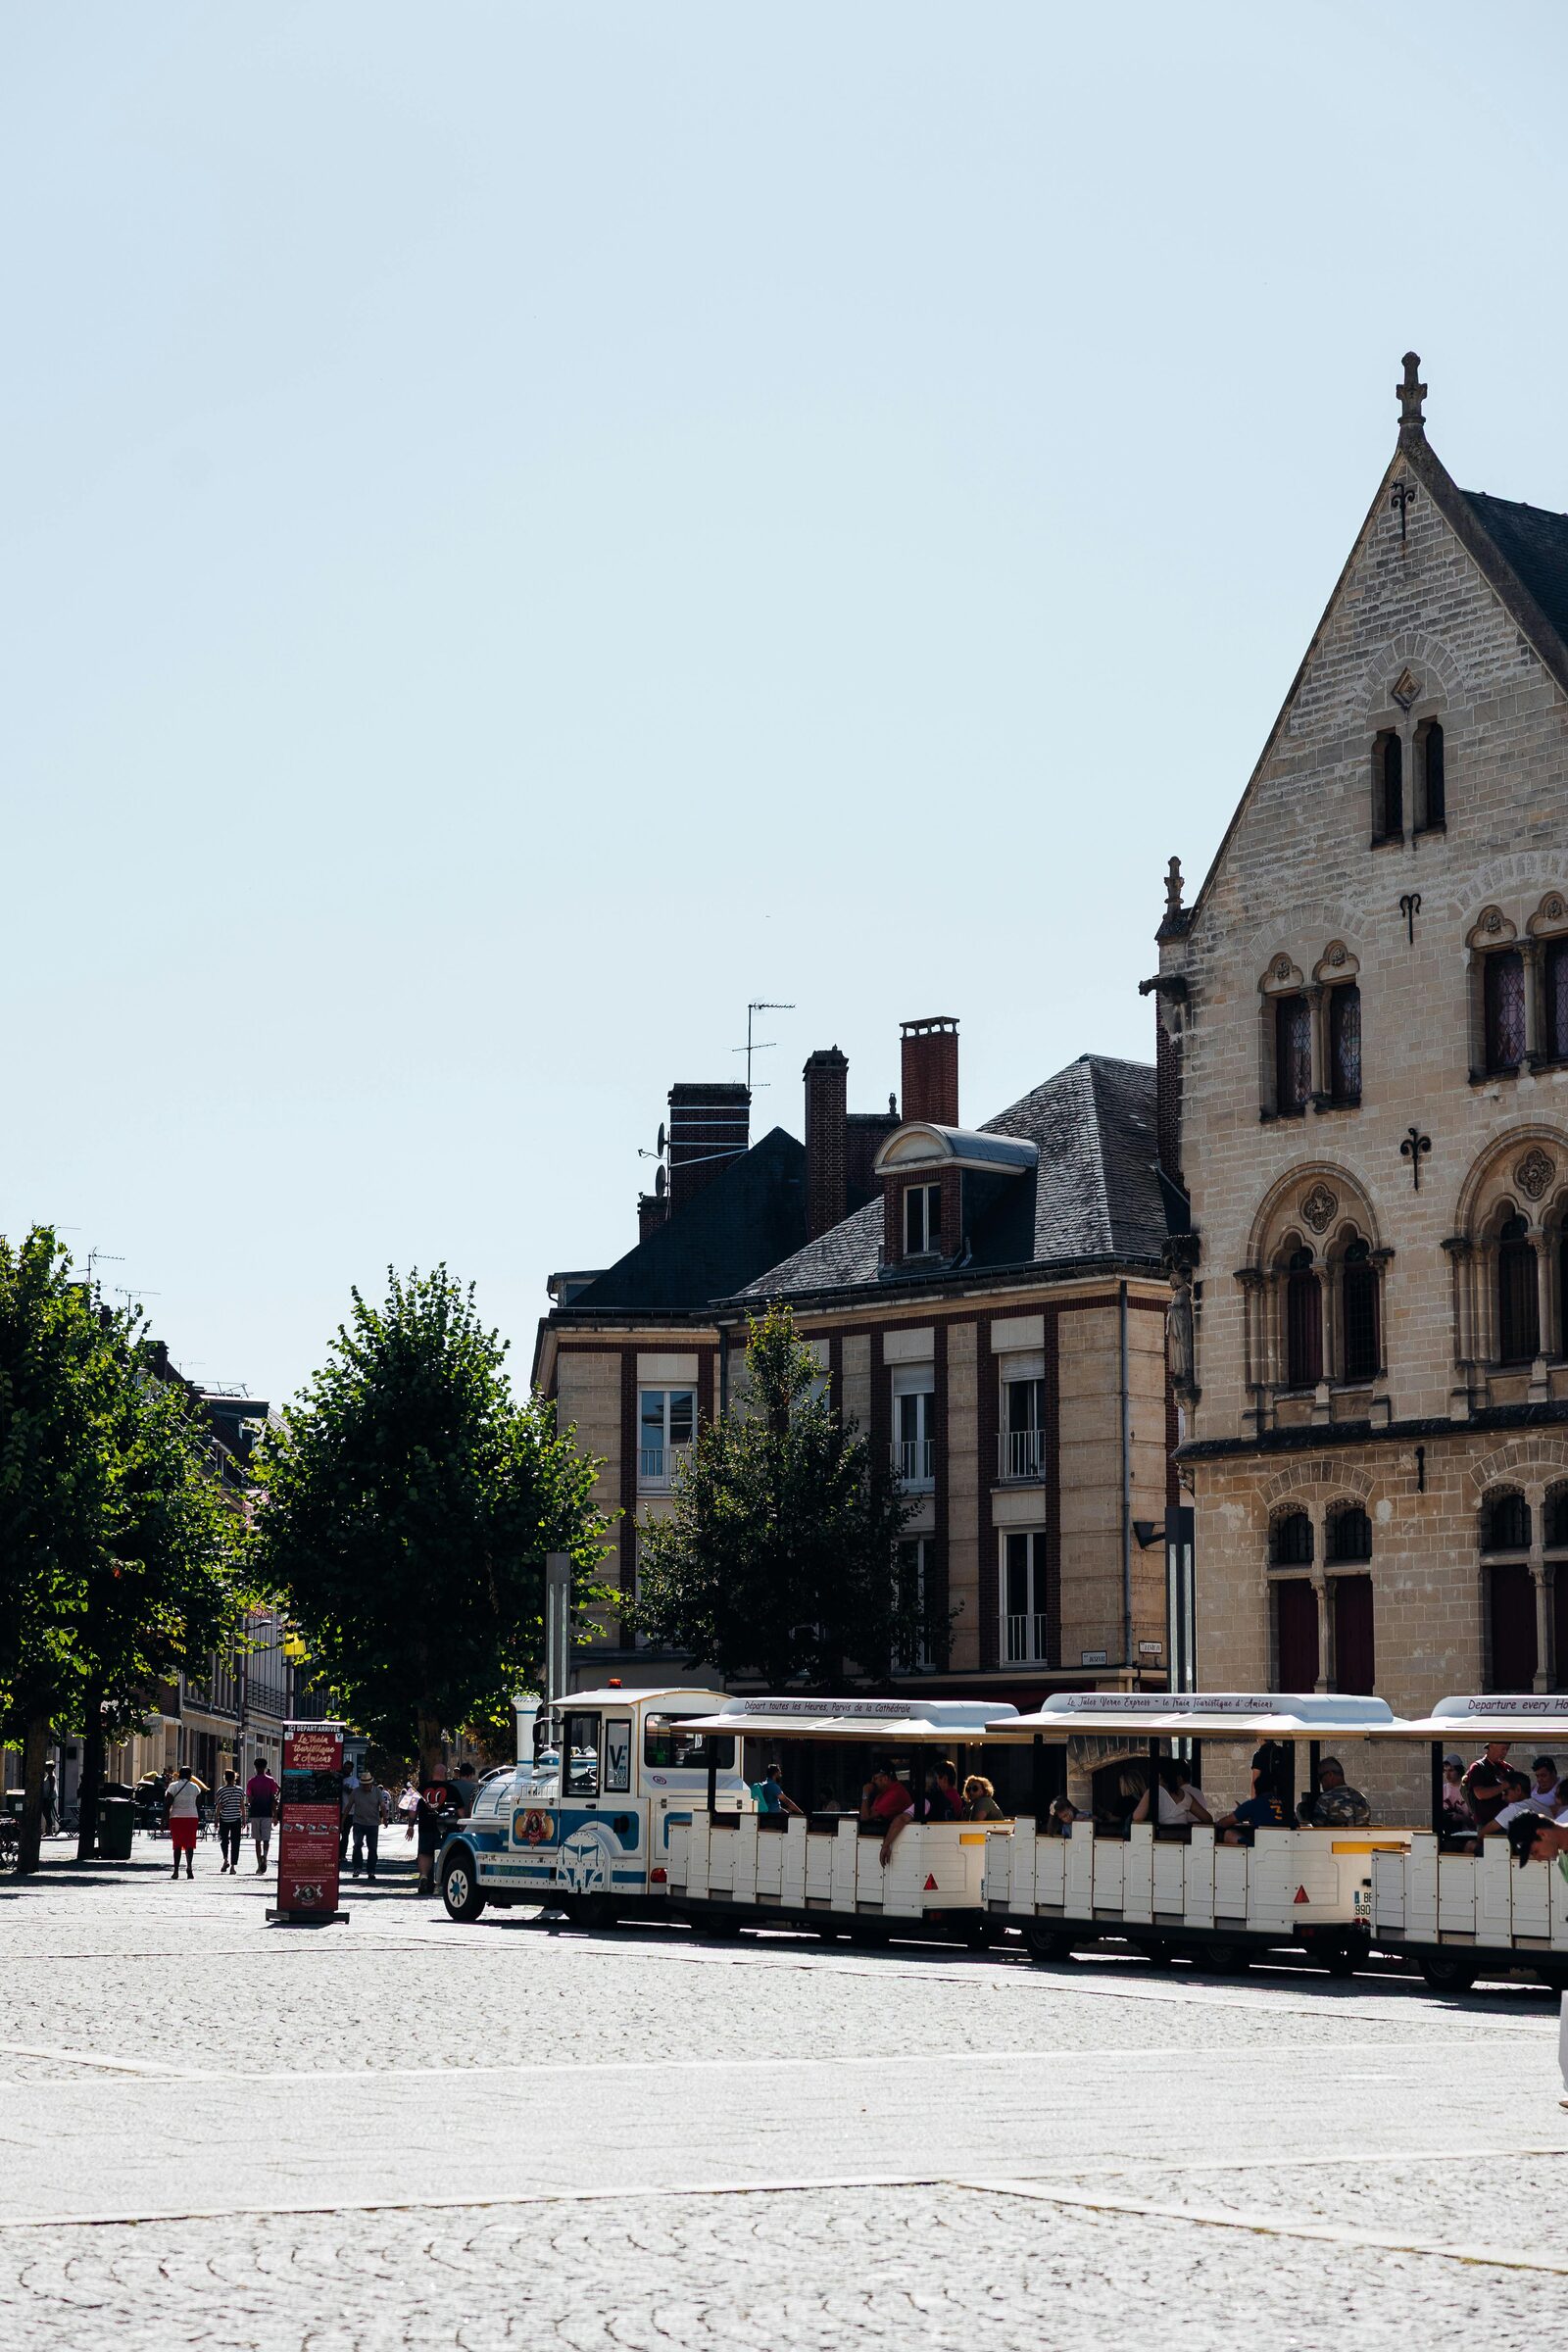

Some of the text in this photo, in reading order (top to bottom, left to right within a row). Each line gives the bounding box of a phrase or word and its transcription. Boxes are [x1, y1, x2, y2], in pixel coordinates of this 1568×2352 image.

[745, 1700, 911, 1713] Départ toutes les Heures, Parvis de la Cathédrale
[1066, 1696, 1075, 1707] Le
[1077, 1696, 1097, 1707] Jules
[1100, 1696, 1121, 1707] Verne
[1124, 1696, 1151, 1709] Express
[1162, 1697, 1169, 1707] le
[1172, 1697, 1190, 1708] Train
[1193, 1697, 1233, 1709] Touristique
[1467, 1699, 1517, 1713] Departure
[1522, 1701, 1550, 1713] every
